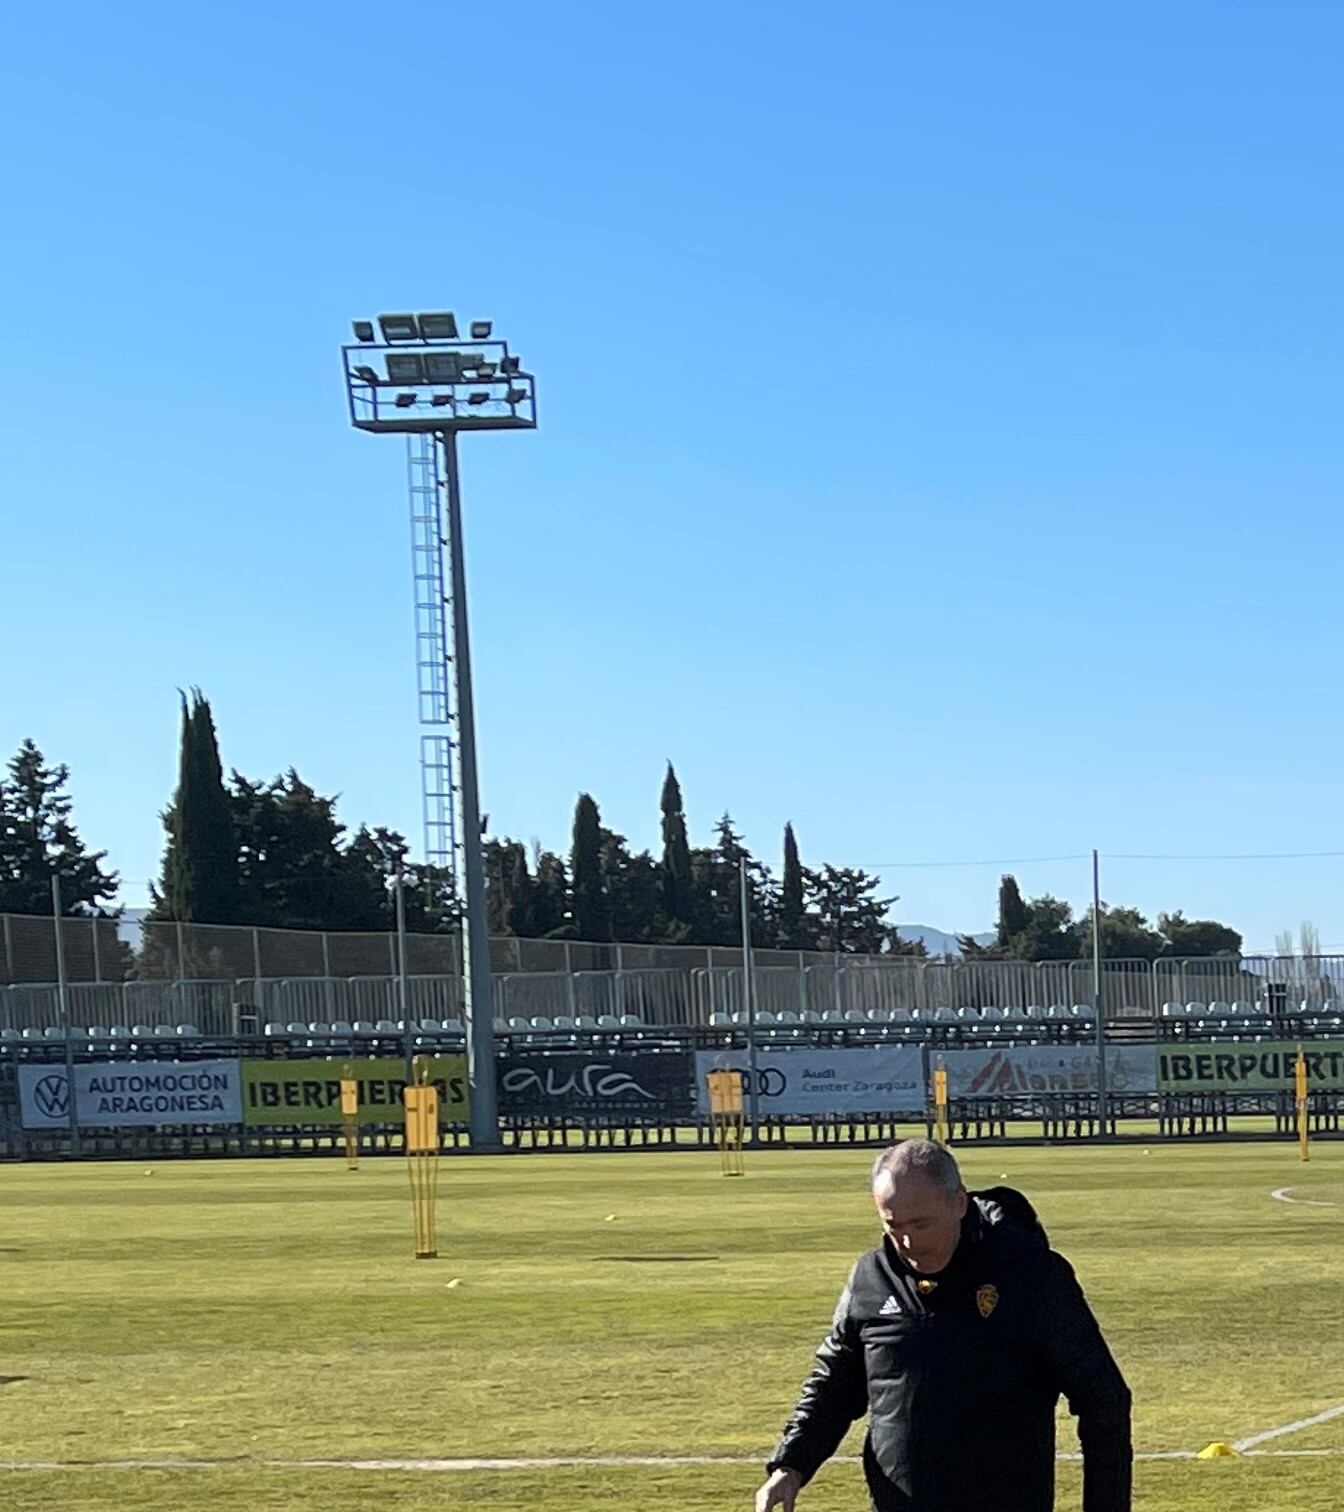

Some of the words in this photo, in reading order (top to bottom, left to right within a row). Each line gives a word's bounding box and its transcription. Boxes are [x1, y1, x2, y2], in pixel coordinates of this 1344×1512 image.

[88, 1068, 229, 1094] AUTOMOCIÓN
[502, 1064, 656, 1099] aura
[801, 1068, 836, 1079] Audi
[97, 1095, 225, 1114] ARAGONESA
[250, 1078, 465, 1108] IBERPERAS
